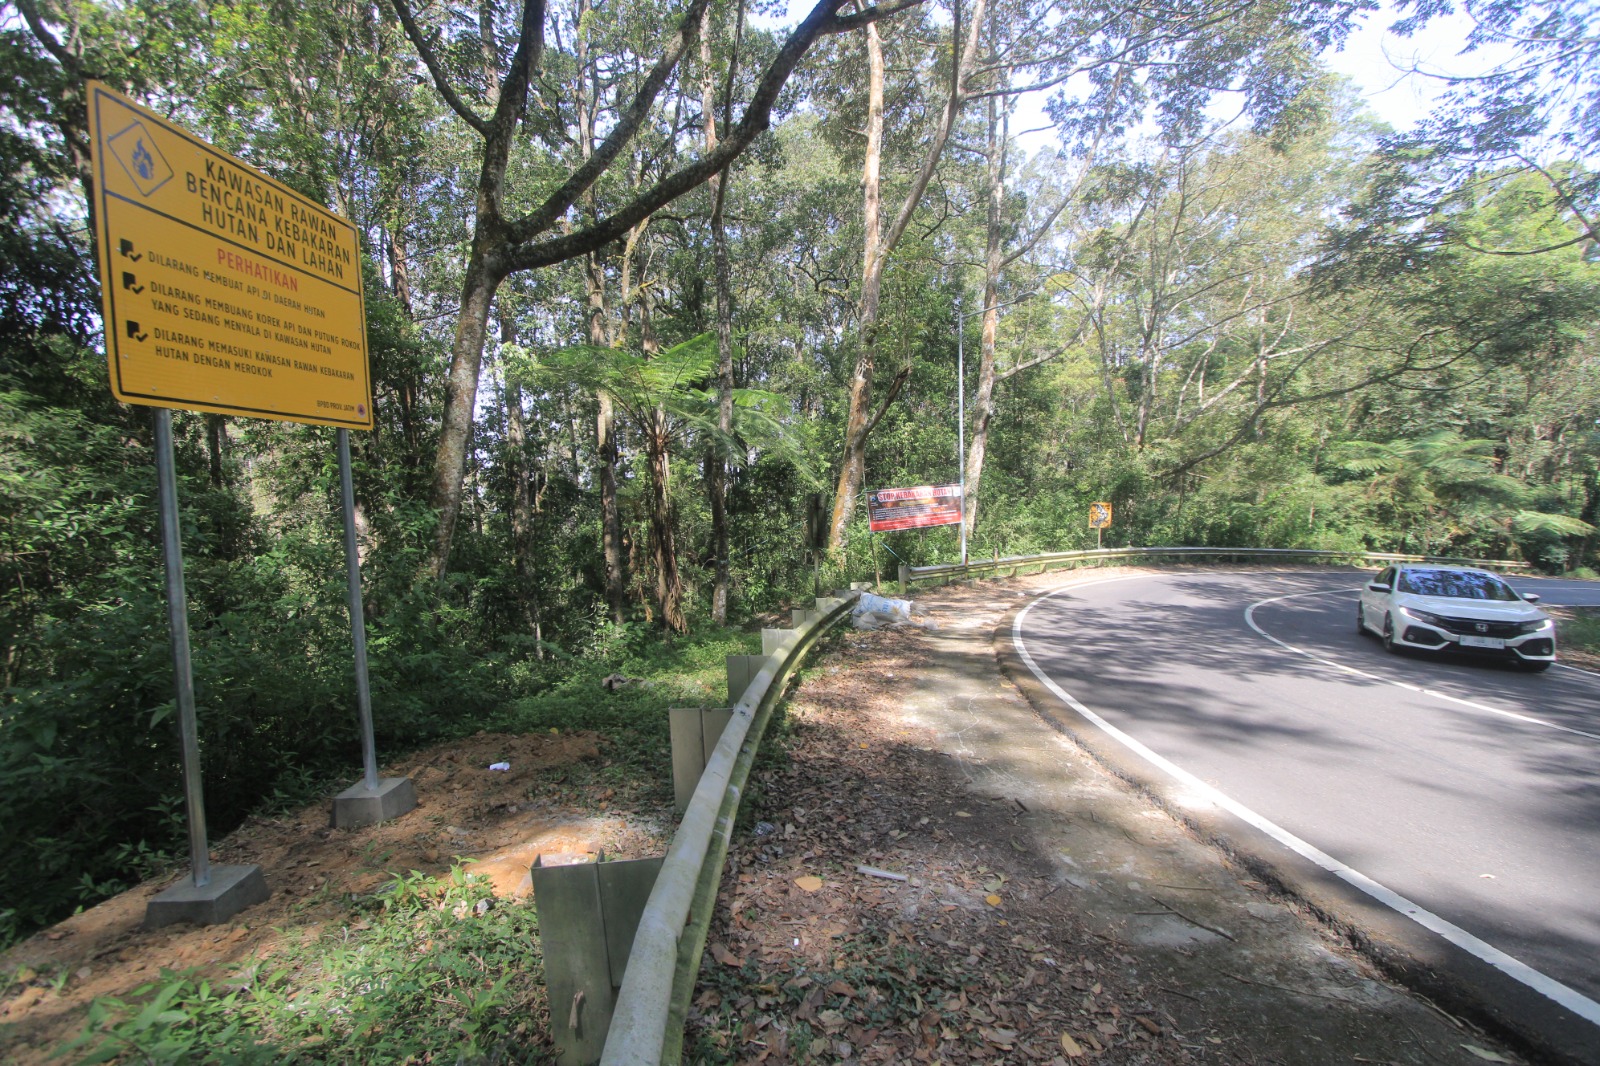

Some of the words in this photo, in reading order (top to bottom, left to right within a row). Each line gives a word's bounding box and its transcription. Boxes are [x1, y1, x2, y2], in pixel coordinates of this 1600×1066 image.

[186, 171, 268, 228] BENCANA
[274, 214, 350, 265] KEBAKARAN
[205, 158, 284, 215] KAWASAN
[291, 203, 336, 241] RAWAN
[202, 201, 258, 244] HUTAN
[266, 231, 295, 260] DAN
[303, 247, 343, 279] LAHAN
[217, 248, 298, 291] PERHATIKAN
[148, 250, 199, 277] DILARANG
[203, 270, 243, 291] MEMBUAT
[247, 284, 259, 297] API
[262, 290, 271, 301] DI
[274, 294, 301, 310] DAERAH
[304, 305, 325, 318] HUTAN
[150, 281, 201, 305] DILARANG
[205, 297, 253, 321] MEMBUANG
[256, 313, 281, 328] KOREK
[283, 321, 295, 332] API
[298, 325, 312, 337] DAN
[314, 330, 339, 344] PUTUNG
[341, 338, 360, 350] ROKOK
[152, 299, 179, 316] YANG
[183, 307, 220, 326] SEDANG
[224, 318, 260, 336] MENYALA
[263, 329, 271, 339] DI
[275, 331, 308, 348] KAWASAN
[311, 342, 331, 355] HUTAN
[154, 328, 204, 349] DILARANG
[208, 340, 252, 359] MEMASUKI
[255, 351, 291, 367] KAWASAN
[294, 360, 317, 373] RAWAN
[320, 366, 354, 380] KEBAKARAN
[155, 345, 189, 361] HUTAN
[193, 353, 231, 370] DENGAN
[234, 361, 272, 377] MEROKOK
[878, 492, 894, 501] STOP
